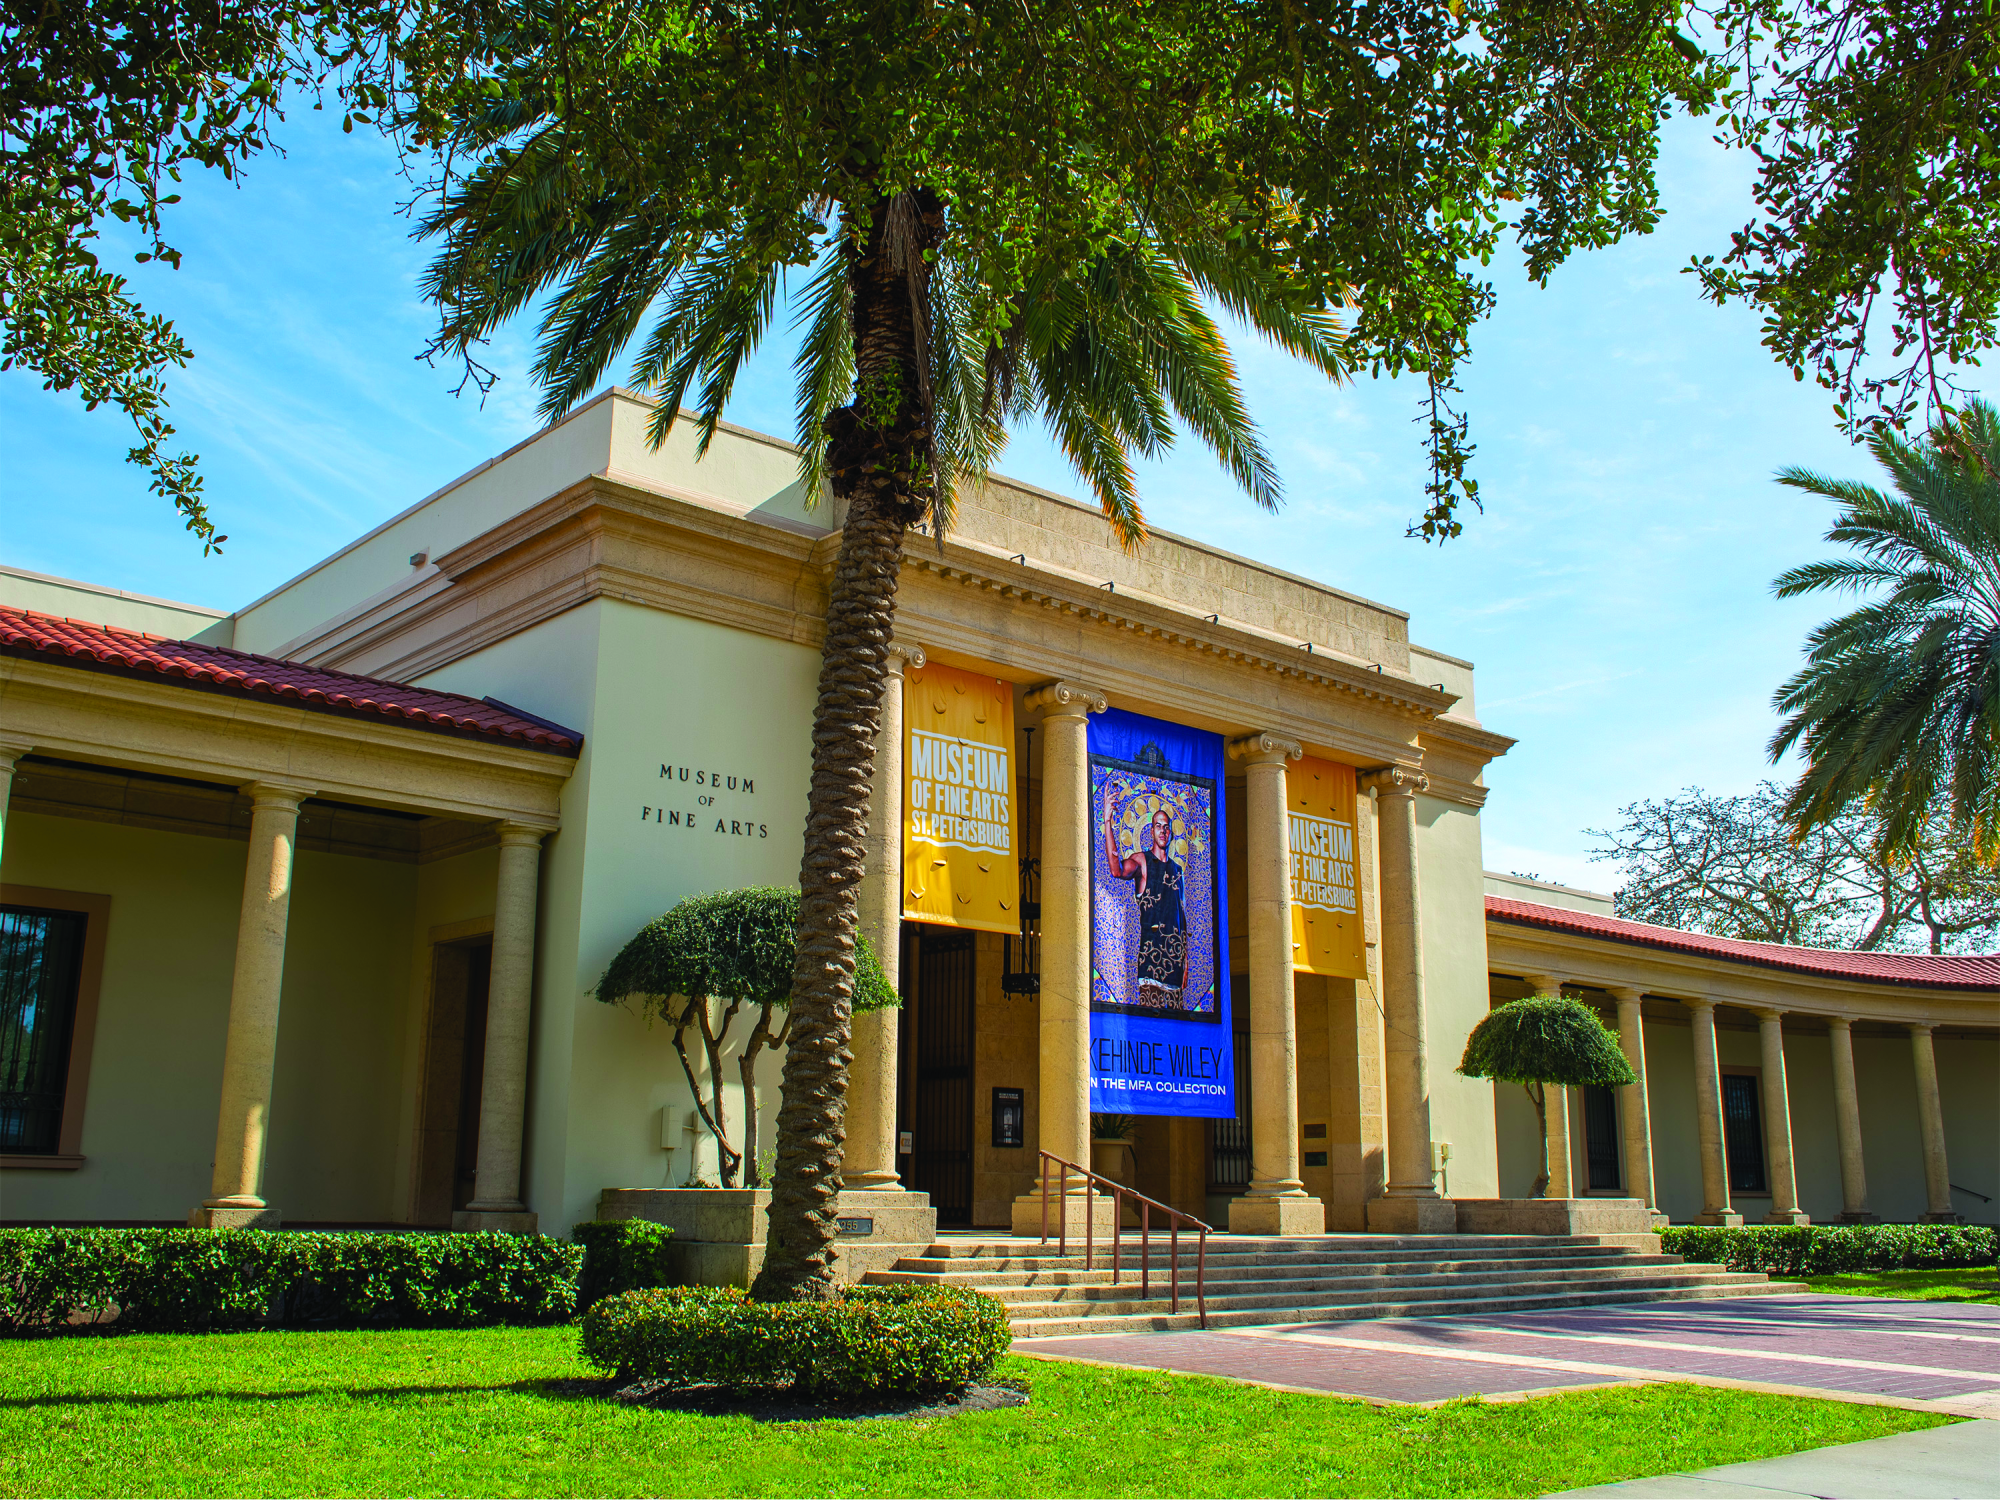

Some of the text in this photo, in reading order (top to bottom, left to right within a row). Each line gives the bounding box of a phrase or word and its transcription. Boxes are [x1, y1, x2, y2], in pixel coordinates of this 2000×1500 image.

[659, 763, 754, 794] MUSEUM
[912, 735, 1009, 795] MUSEUM
[698, 795, 715, 806] OF
[912, 779, 1009, 824] OF FINE ARTS
[641, 806, 768, 838] FINE ARTS
[1288, 816, 1353, 862] MUSEUM
[1302, 855, 1327, 883] FINE
[1328, 860, 1355, 888] ARTS
[1090, 1037, 1223, 1079] KEHINDE WILEY
[1101, 1077, 1126, 1090] THE
[1128, 1079, 1154, 1092] MFA
[1155, 1081, 1227, 1096] COLLECTION
